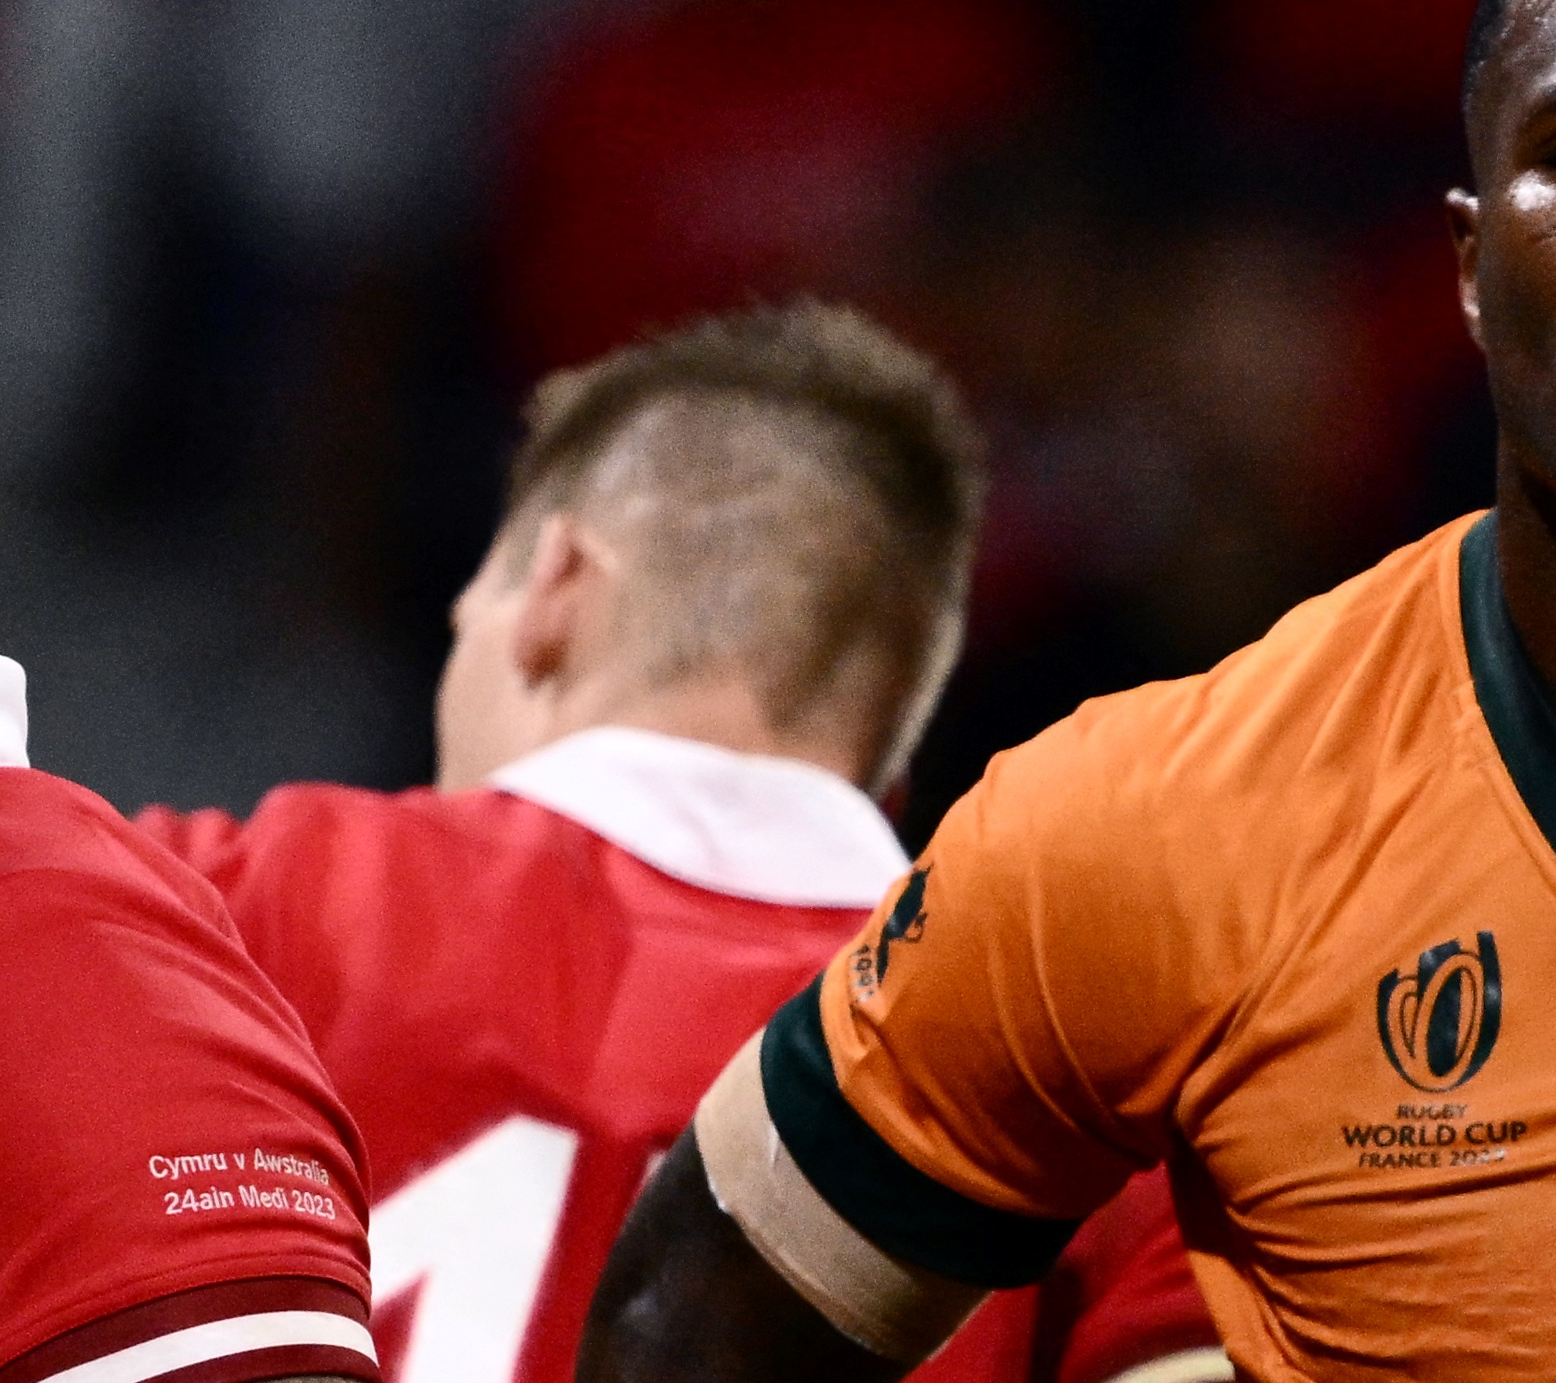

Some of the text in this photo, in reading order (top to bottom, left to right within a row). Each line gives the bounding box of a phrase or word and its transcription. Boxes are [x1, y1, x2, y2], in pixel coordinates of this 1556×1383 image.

[1397, 1104, 1467, 1120] RUGBY
[1341, 1121, 1528, 1148] WORLD CUP
[149, 1147, 330, 1186] Cymru v Awstralia
[1359, 1152, 1441, 1169] FRANCE
[164, 1184, 336, 1220] 24ain Medi 2023
